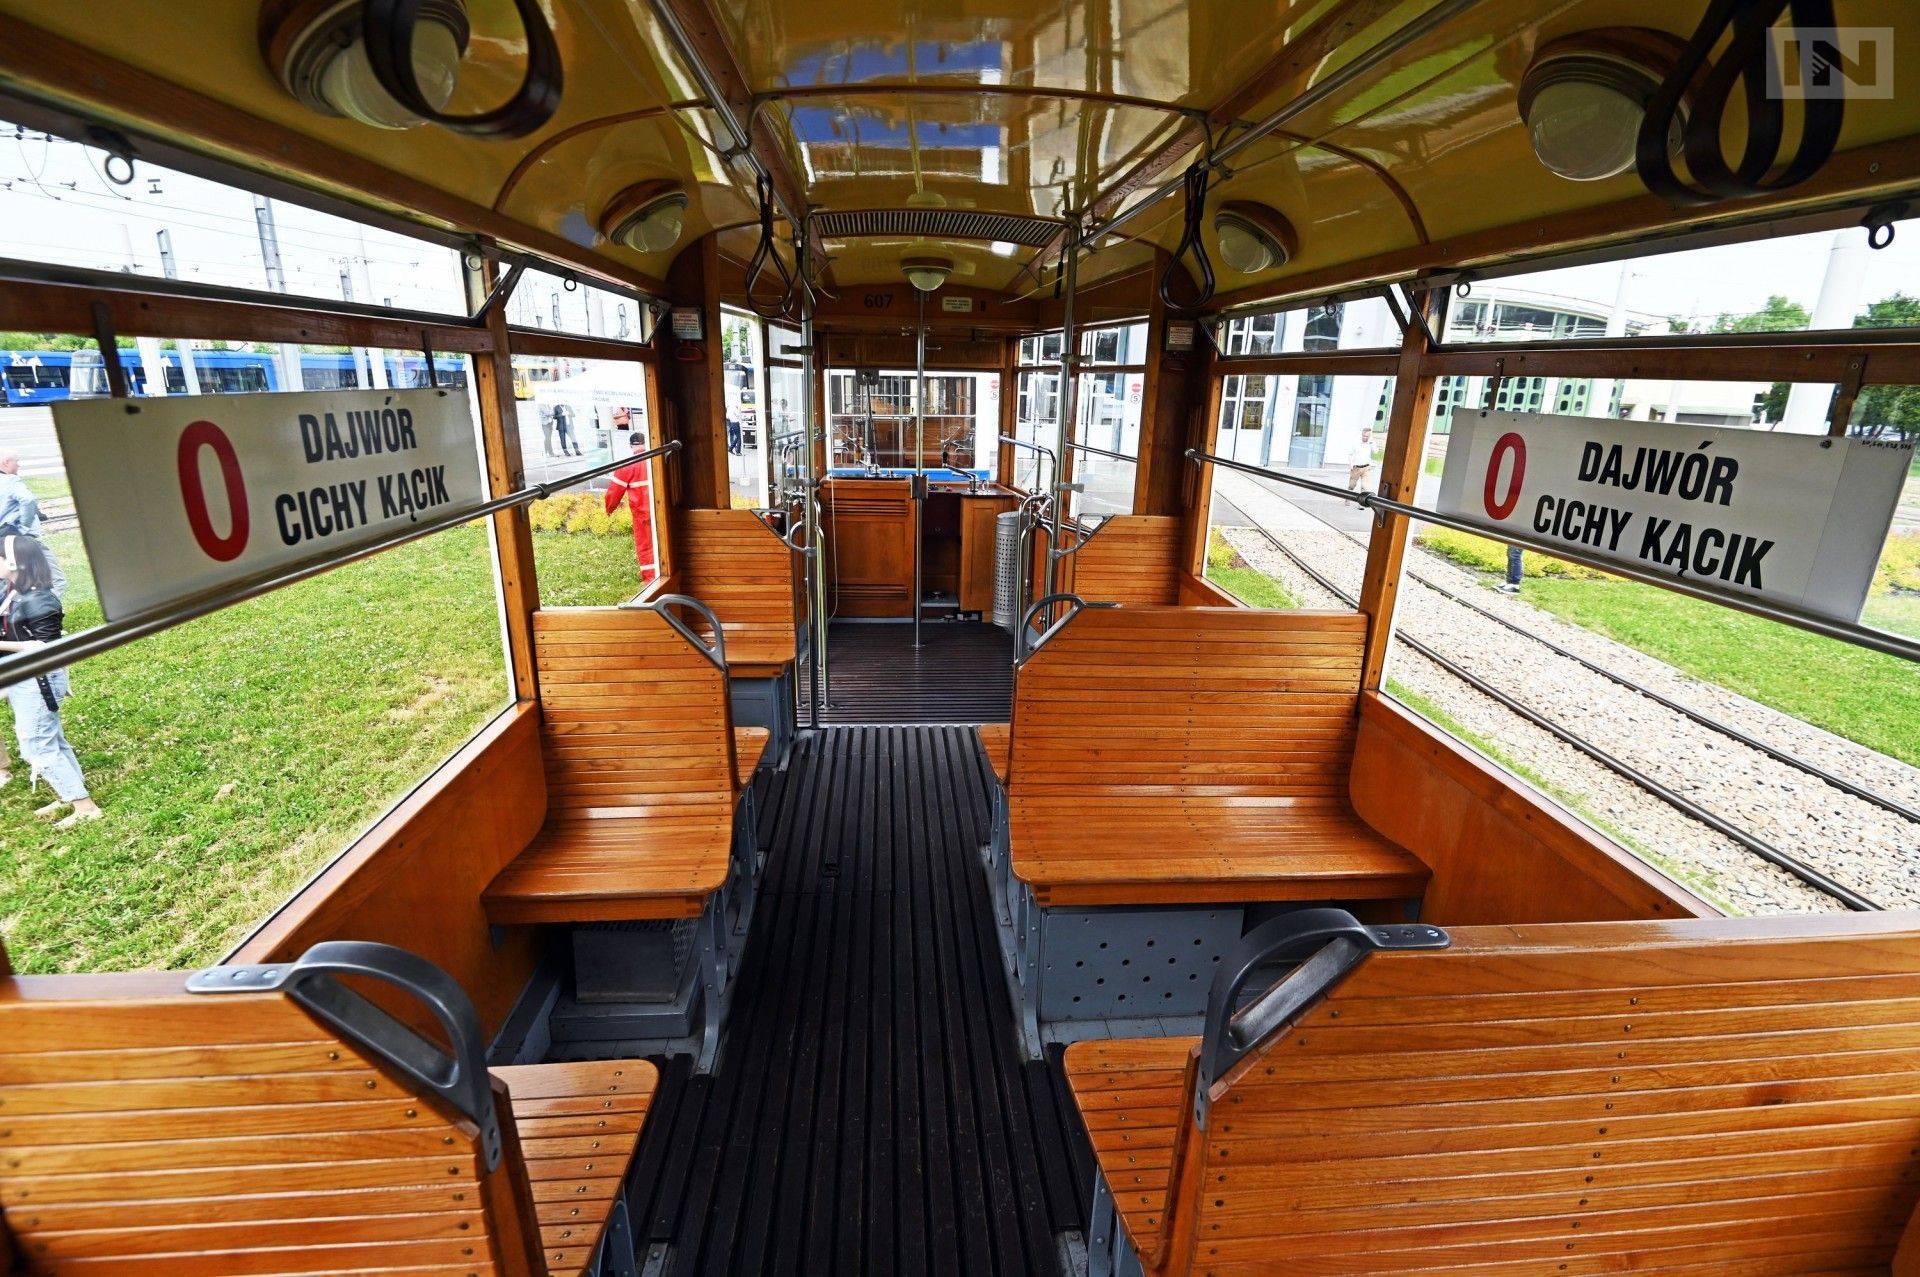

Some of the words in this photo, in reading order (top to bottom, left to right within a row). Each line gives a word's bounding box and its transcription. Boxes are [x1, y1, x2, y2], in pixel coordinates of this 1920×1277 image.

[863, 293, 894, 309] 607
[298, 396, 418, 464] DAJWÓR
[177, 420, 249, 561] 0
[274, 479, 368, 546] CICHY
[377, 464, 450, 523] KĄCIK
[1483, 431, 1527, 521] 0
[1577, 440, 1739, 507] DAJWÓR
[1533, 494, 1634, 552] CICHY
[1638, 515, 1776, 590] KĄCIK
